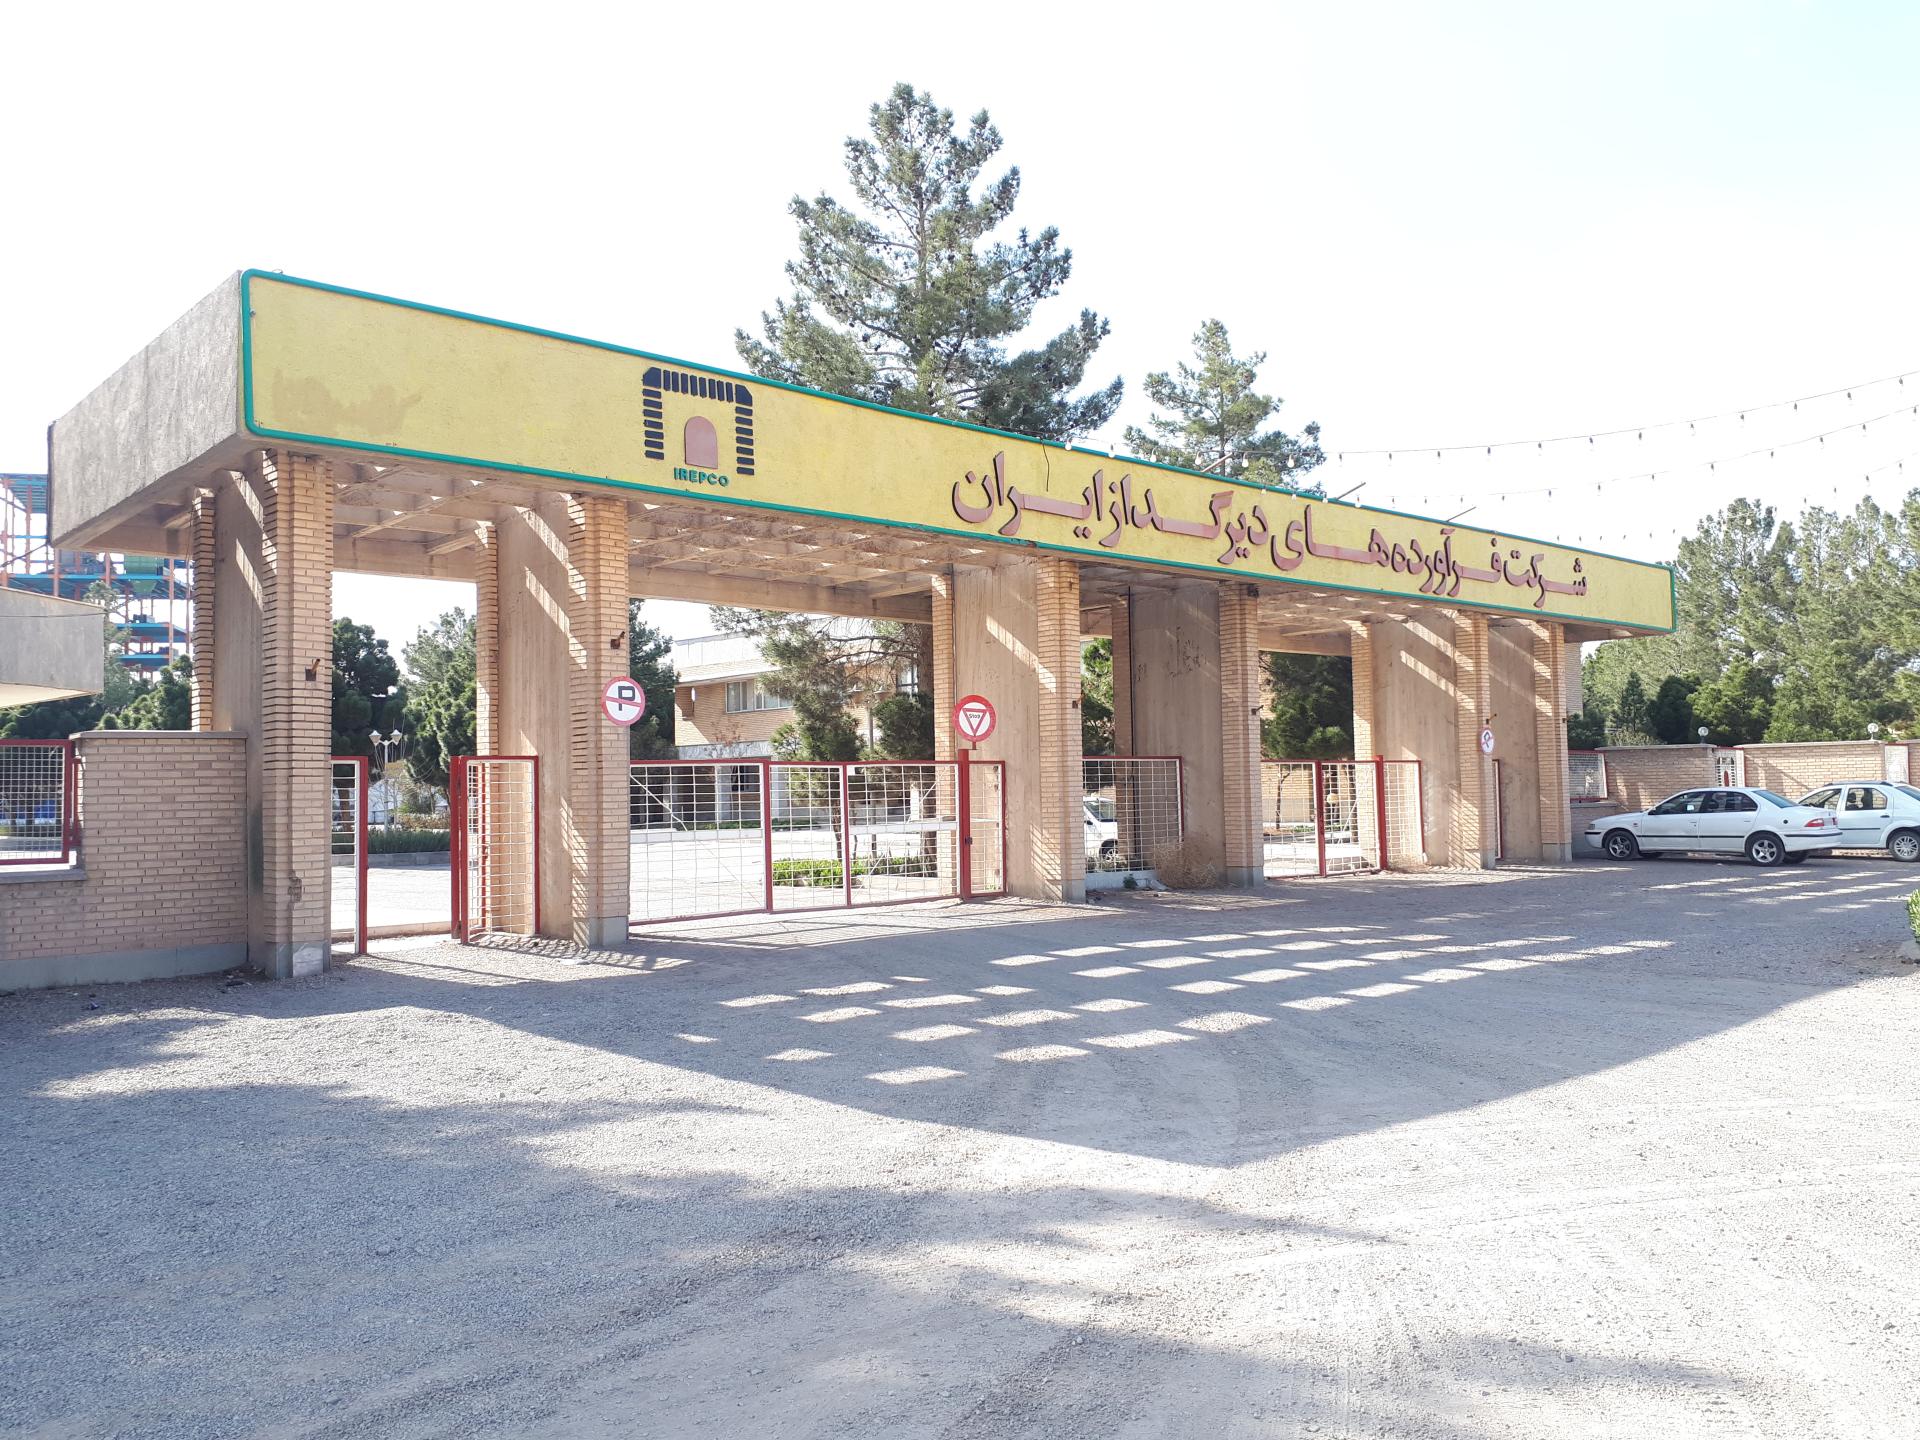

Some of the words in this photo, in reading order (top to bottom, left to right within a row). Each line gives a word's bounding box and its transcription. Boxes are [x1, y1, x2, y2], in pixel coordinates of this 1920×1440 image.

[673, 466, 729, 487] IREPCO
[951, 450, 1103, 536] ایران
[1503, 549, 1588, 608] شرکت
[617, 685, 636, 711] P
